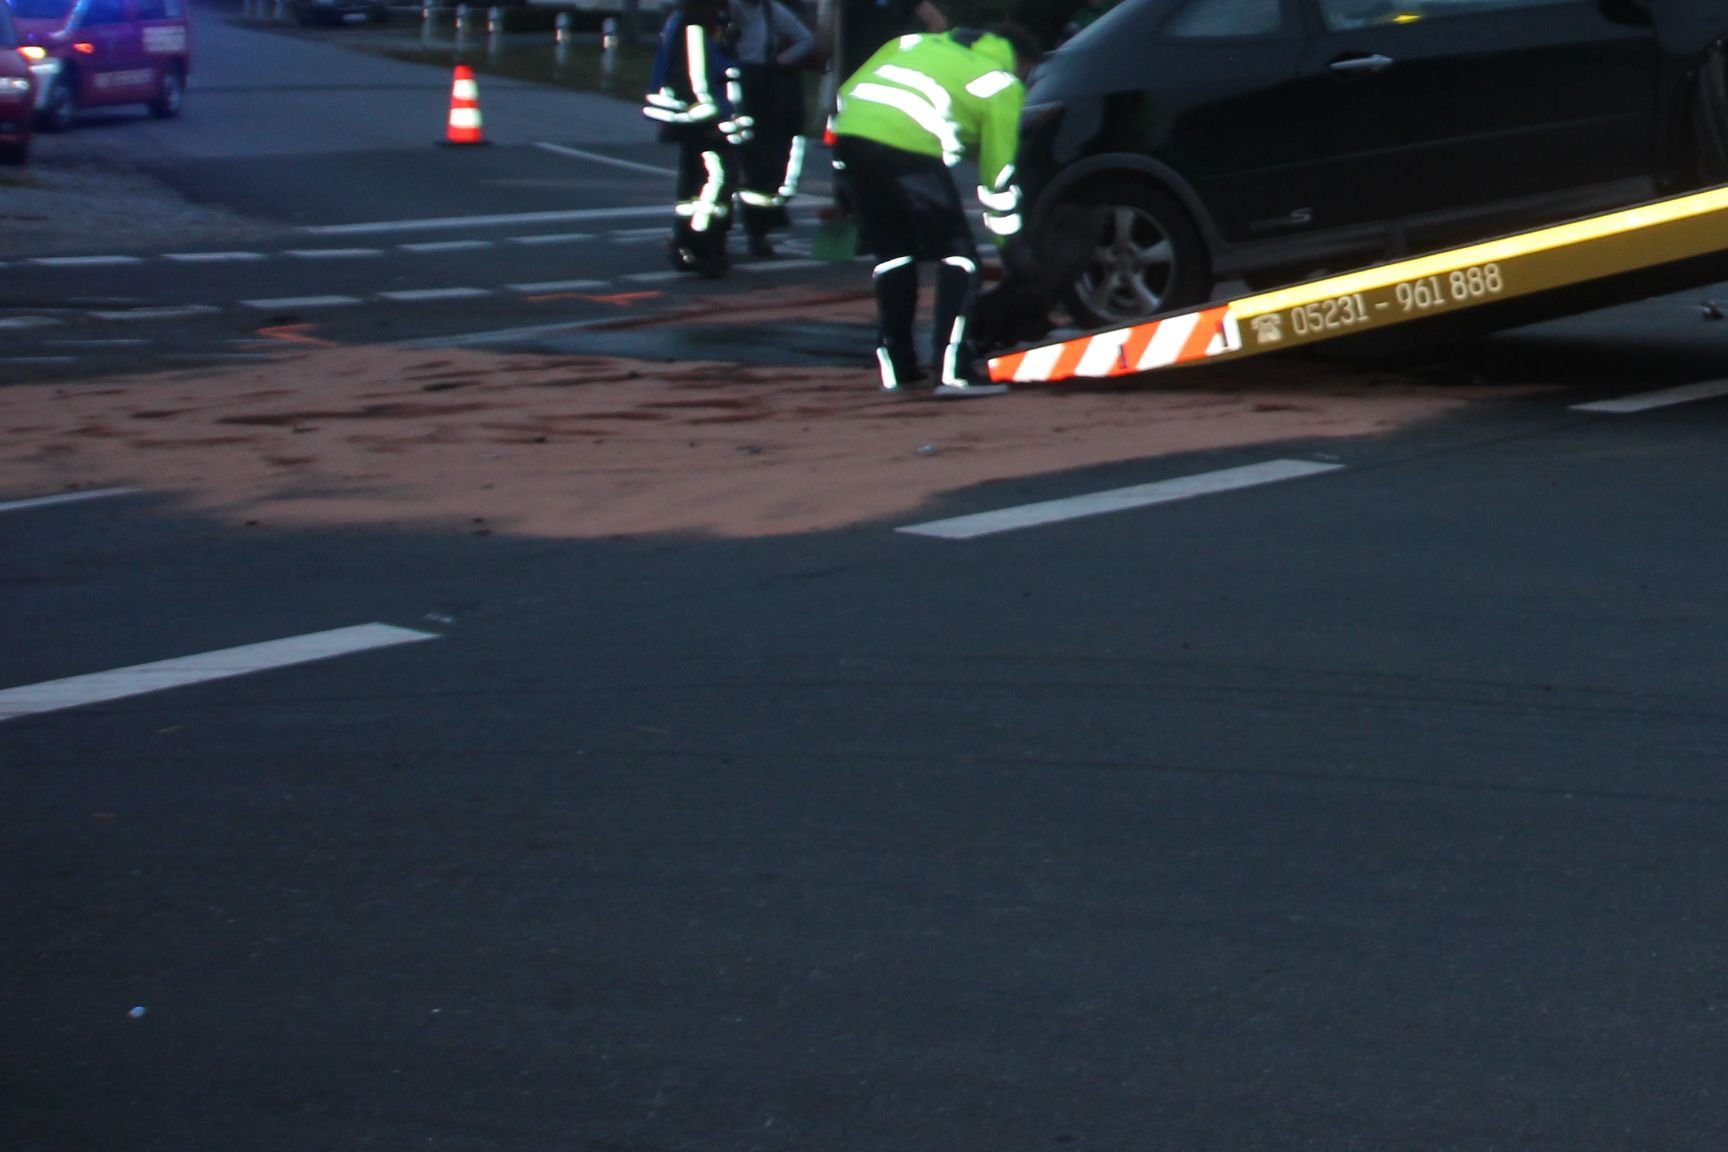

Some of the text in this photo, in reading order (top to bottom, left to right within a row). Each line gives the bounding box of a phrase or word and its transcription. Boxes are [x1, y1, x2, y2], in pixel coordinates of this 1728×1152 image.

[1290, 293, 1368, 335] 05231
[1395, 276, 1445, 311] 961
[1450, 263, 1504, 299] 888
